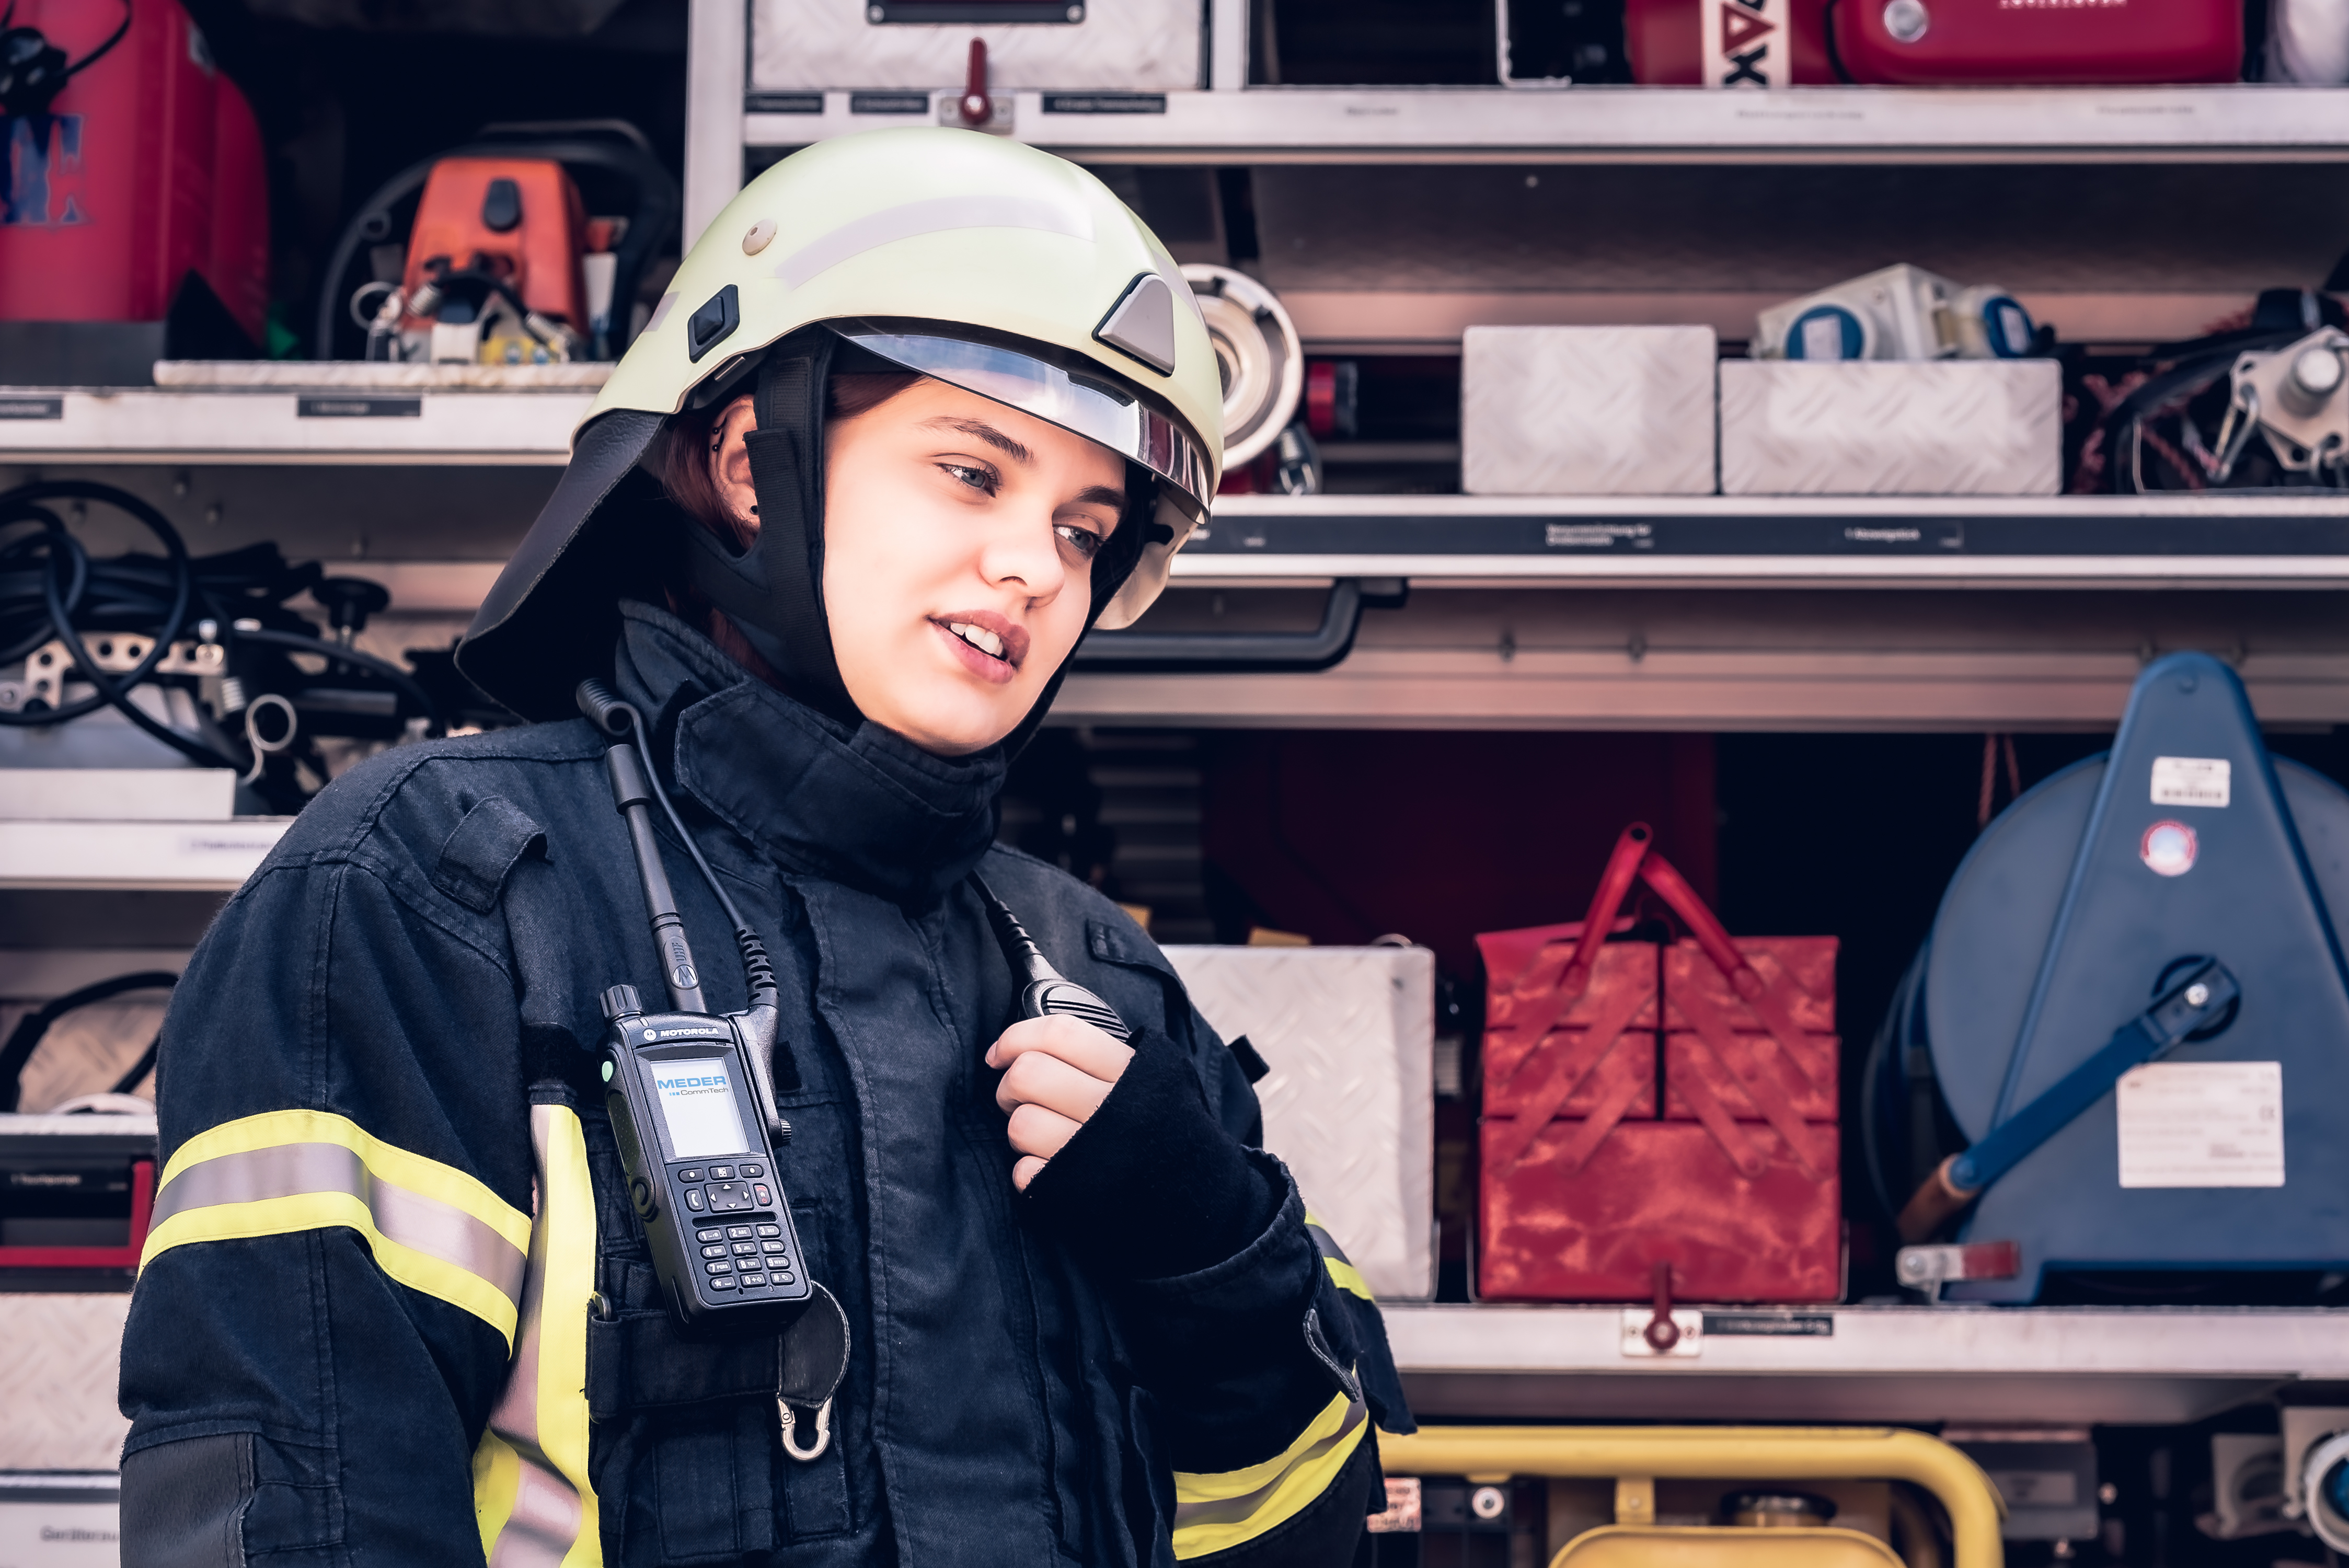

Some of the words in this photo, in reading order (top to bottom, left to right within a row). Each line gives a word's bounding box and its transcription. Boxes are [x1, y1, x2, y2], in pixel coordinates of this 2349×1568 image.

[671, 942, 687, 962] UHF
[660, 1028, 719, 1037] MOTOROLA
[657, 1076, 727, 1089] MEDER
[731, 1229, 738, 1237] 2
[759, 1227, 766, 1235] 3
[701, 1232, 707, 1240] 1
[735, 1244, 742, 1253] 5
[764, 1243, 770, 1251] 6
[740, 1260, 747, 1269] 8
[768, 1259, 774, 1267] 9
[709, 1264, 716, 1273] 7
